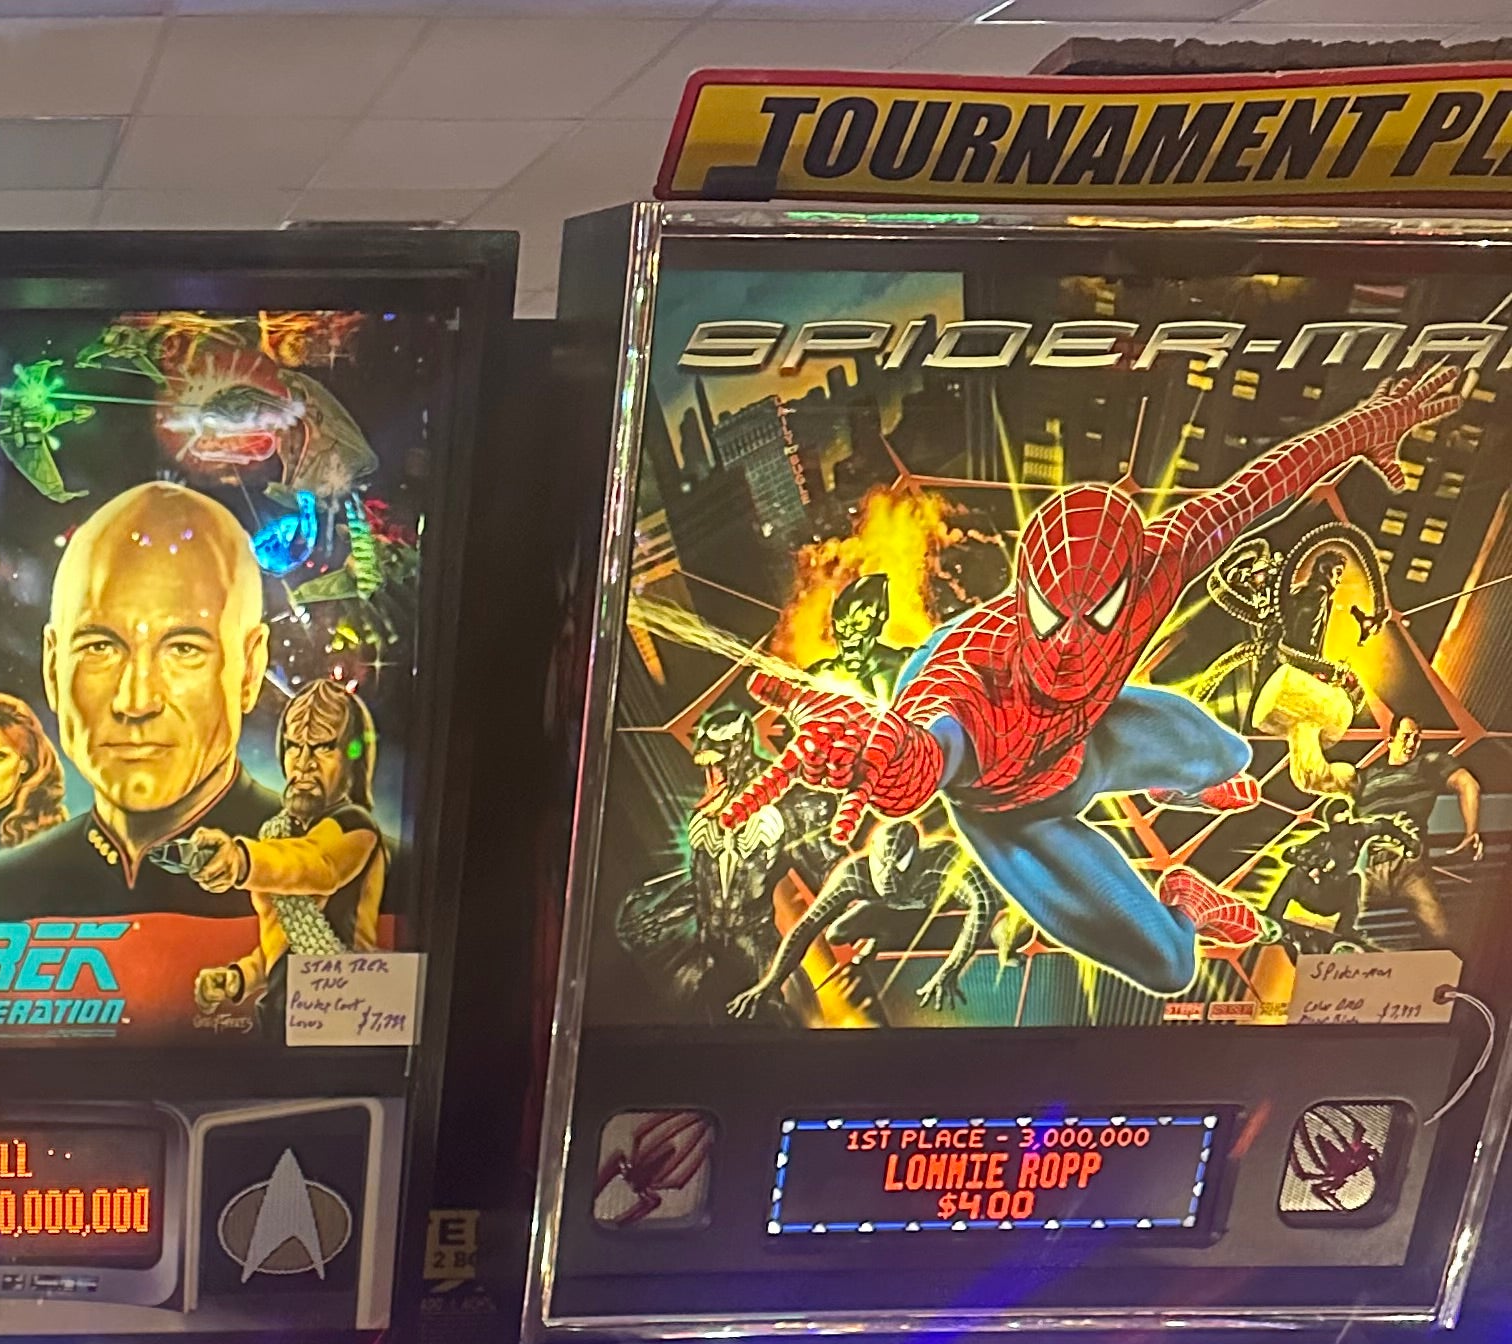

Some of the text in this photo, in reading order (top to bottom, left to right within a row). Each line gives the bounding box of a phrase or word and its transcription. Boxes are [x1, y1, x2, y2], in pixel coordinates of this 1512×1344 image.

[759, 88, 1512, 186] TOURNAMENT PL
[678, 318, 1512, 372] SPIDER-MA
[300, 960, 341, 974] STAR
[846, 1130, 892, 1151] 1ST
[902, 1128, 986, 1150] PLACE
[1018, 1128, 1151, 1152] 3,000,000
[1018, 1151, 1103, 1190] ROPP
[937, 1189, 1037, 1222] $4.00
